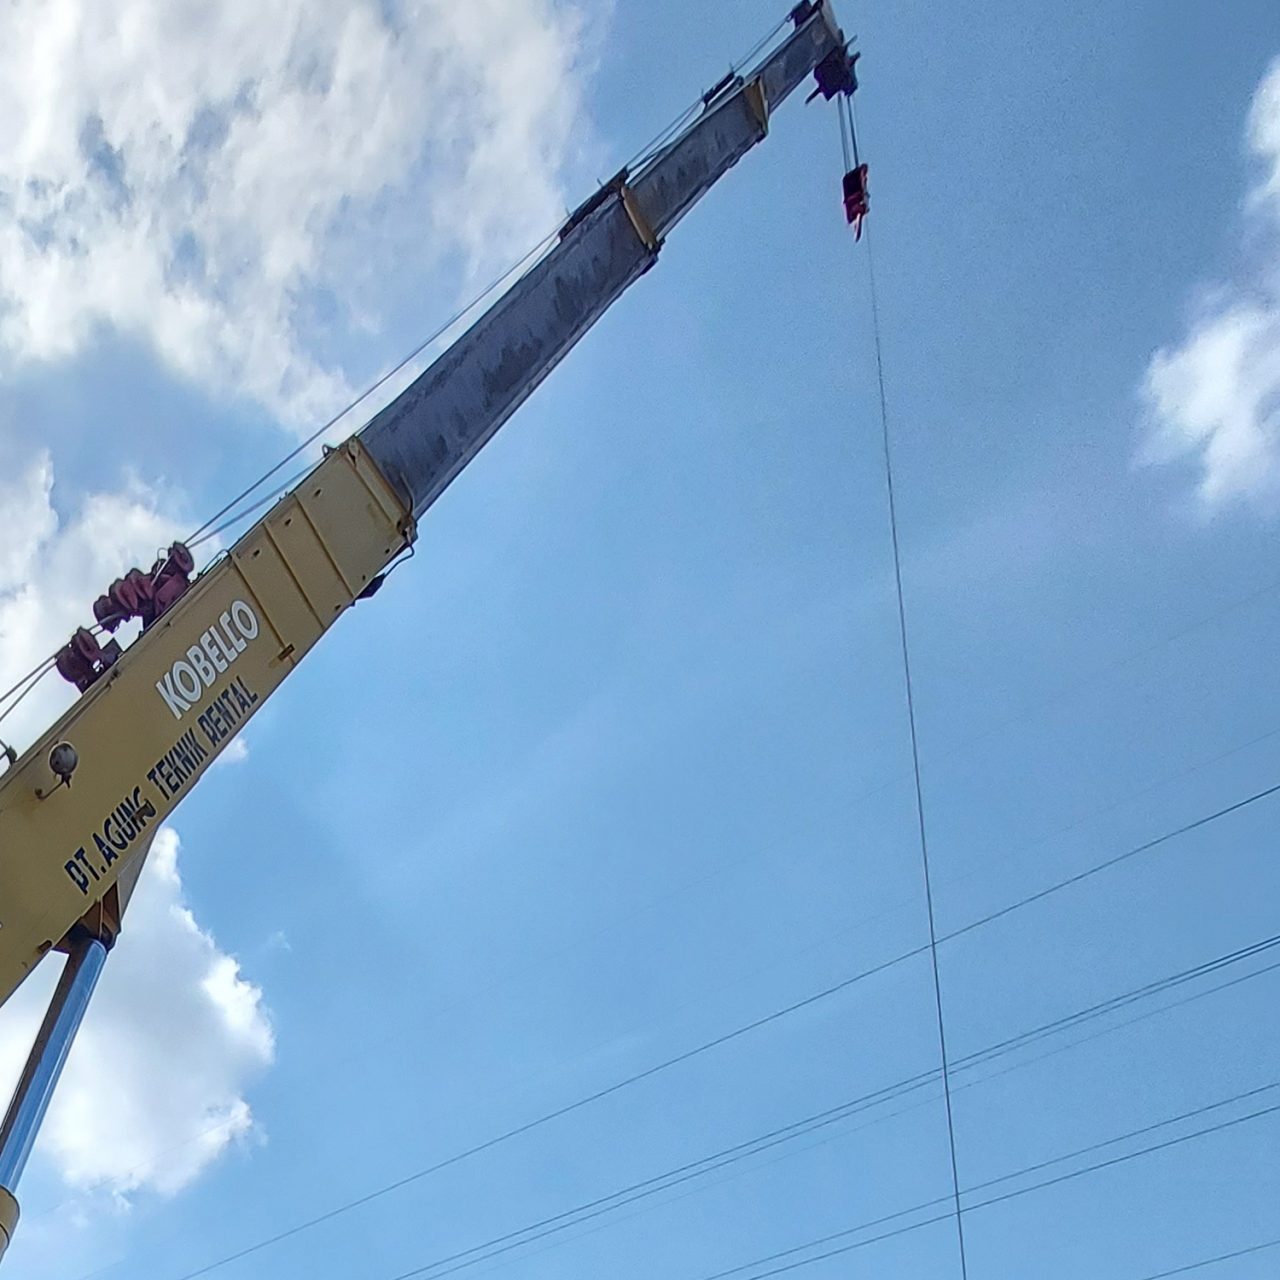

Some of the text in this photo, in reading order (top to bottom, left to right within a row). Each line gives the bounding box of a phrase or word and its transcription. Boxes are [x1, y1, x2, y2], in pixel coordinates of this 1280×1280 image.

[156, 599, 259, 720] KOBELCO
[146, 727, 209, 801] TEKNIK
[197, 674, 259, 748] RENTAL
